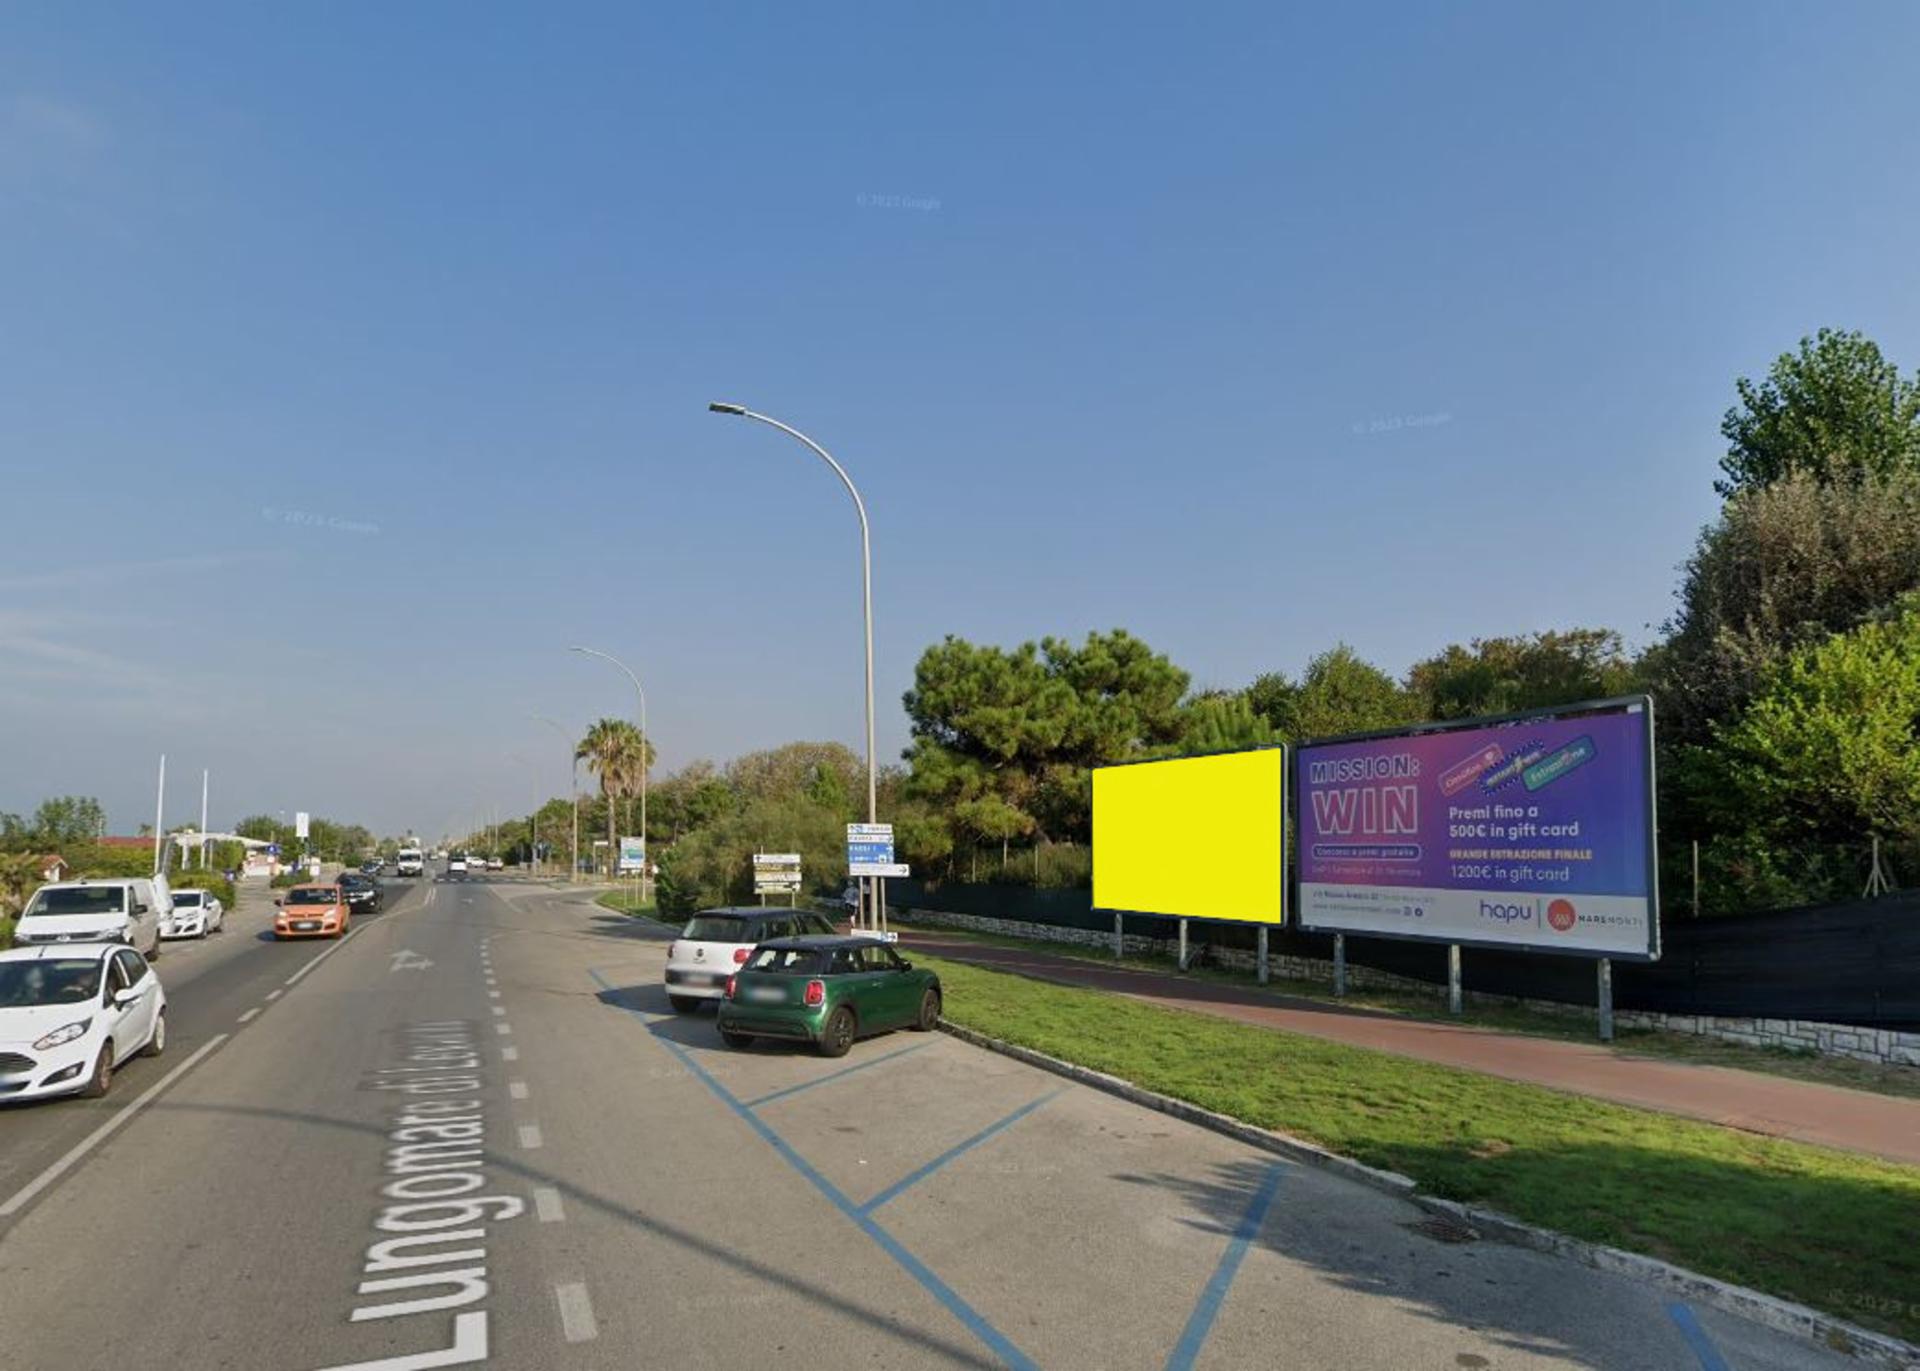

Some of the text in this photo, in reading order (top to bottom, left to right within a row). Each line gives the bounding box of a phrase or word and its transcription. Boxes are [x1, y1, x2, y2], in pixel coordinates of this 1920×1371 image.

[1311, 753, 1421, 783] MISSION:
[1312, 786, 1418, 834] WIN
[1449, 804, 1539, 820] Premi fino a
[1449, 820, 1580, 841] 500€ in gift card
[1490, 848, 1552, 860] ESTRAZIONE
[1555, 848, 1593, 860] FINALE
[1452, 865, 1570, 883] 1200€ in gift card
[1480, 898, 1532, 924] hapu
[313, 1099, 525, 1371] Lungomare
